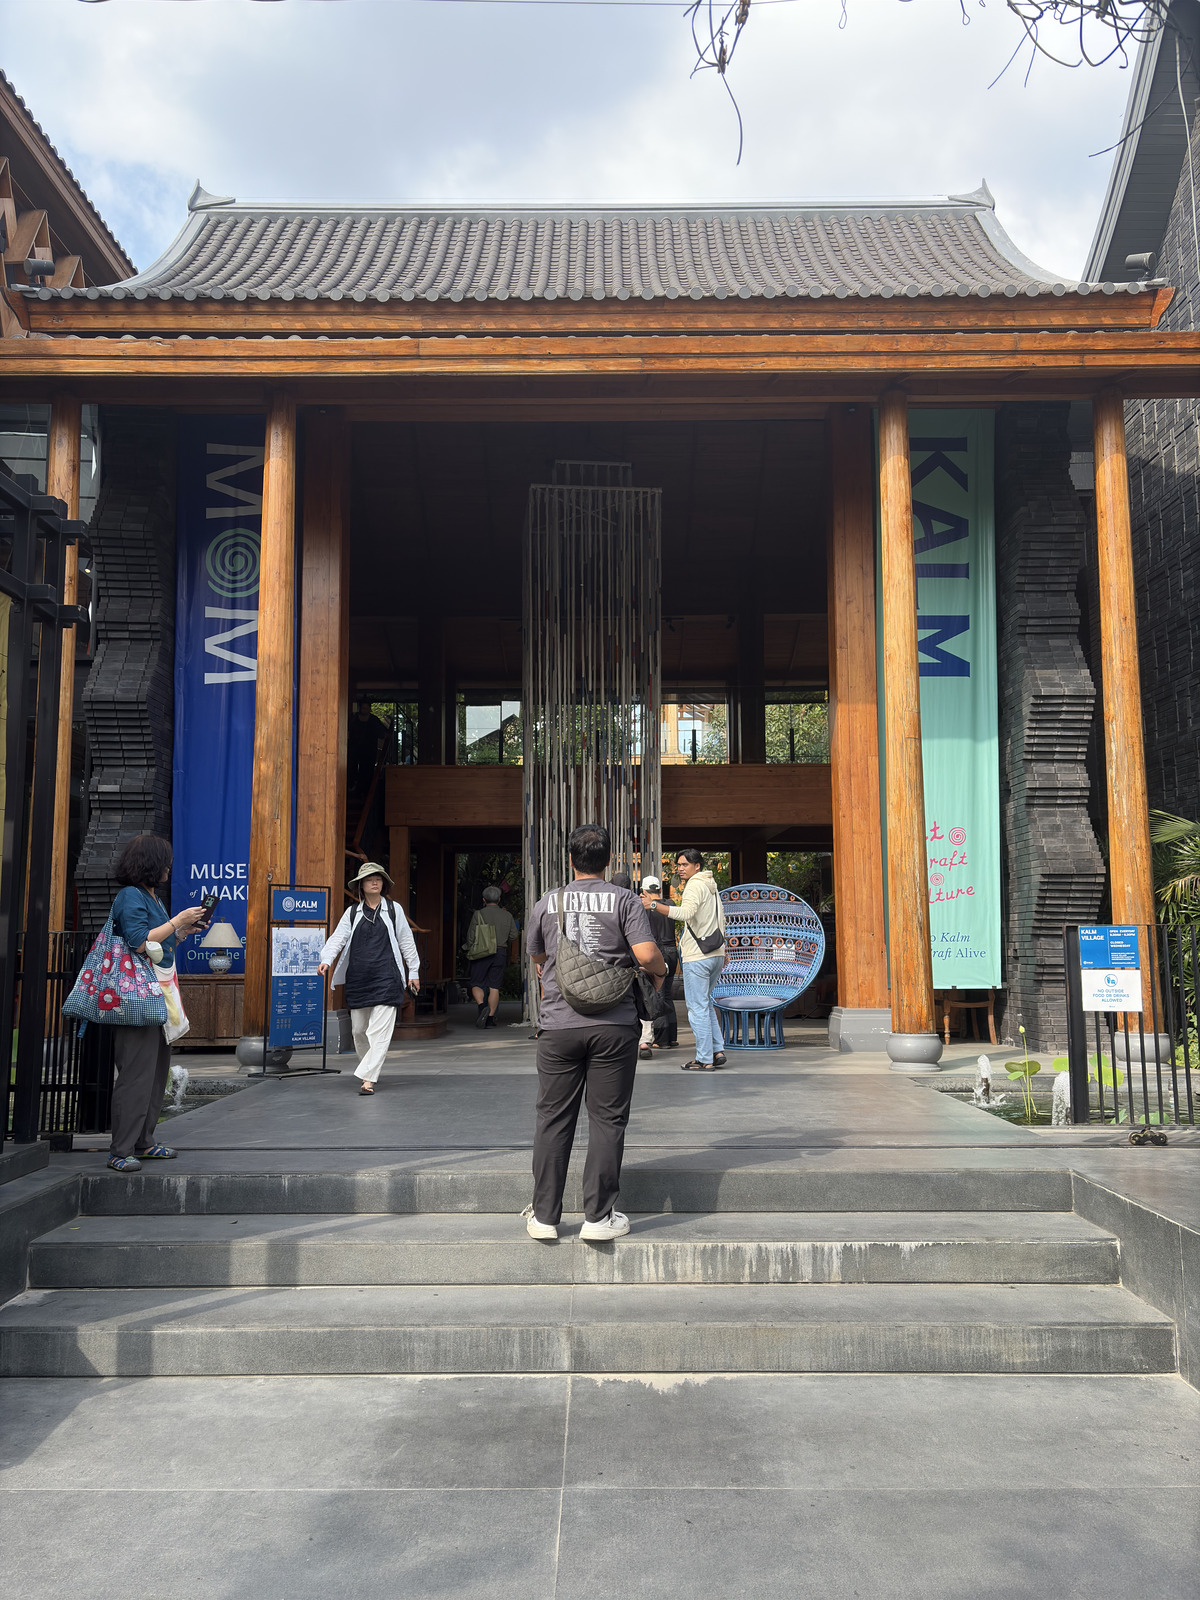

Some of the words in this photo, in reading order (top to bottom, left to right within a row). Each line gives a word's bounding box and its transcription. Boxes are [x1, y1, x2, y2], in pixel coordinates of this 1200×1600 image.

[909, 437, 970, 677] KALM
[927, 850, 969, 871] raft
[190, 863, 250, 879] MUSE
[189, 889, 198, 899] of
[200, 885, 249, 901] MAK
[928, 885, 976, 904] lture
[296, 900, 318, 908] KALM
[548, 892, 613, 913] NRVANA
[940, 932, 970, 943] Kalm
[930, 948, 952, 959] raft
[955, 947, 987, 958] Alive
